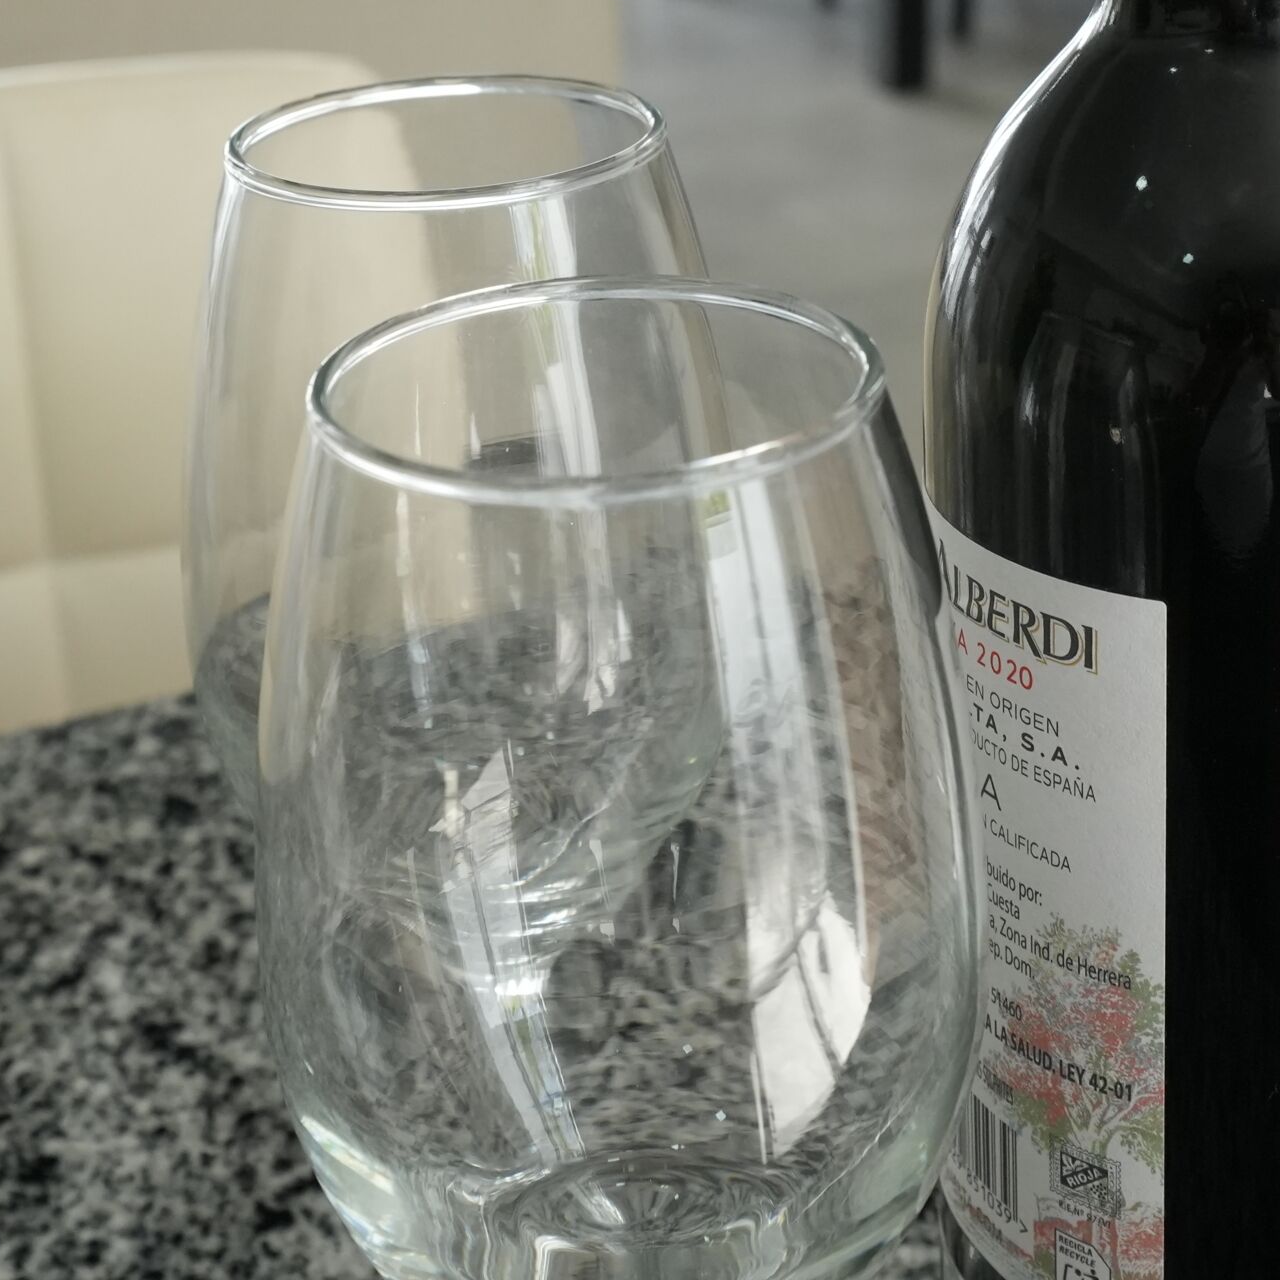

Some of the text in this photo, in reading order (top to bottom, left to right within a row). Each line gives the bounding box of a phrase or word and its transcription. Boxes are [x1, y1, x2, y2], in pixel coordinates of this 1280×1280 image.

[976, 641, 1034, 691] 2020
[966, 674, 1060, 738] EN ORIGEN
[1011, 753, 1030, 778] DE
[1033, 765, 1097, 803] ESPAÑA
[990, 818, 1072, 873] CALIFICADA
[986, 855, 1043, 907] buido por:
[999, 917, 1027, 950] Zona
[1030, 935, 1053, 963] Ind.
[1056, 951, 1074, 971] de
[1077, 956, 1132, 990] Herrera
[1005, 946, 1036, 980] Dom.
[994, 1020, 1008, 1047] LA
[1059, 1058, 1085, 1085] LEY
[1088, 1073, 1133, 1102] 42-01
[1068, 1169, 1105, 1188] RIOJA
[1058, 1235, 1094, 1257] RECICLA
[1058, 1246, 1097, 1268] RECYCLE
